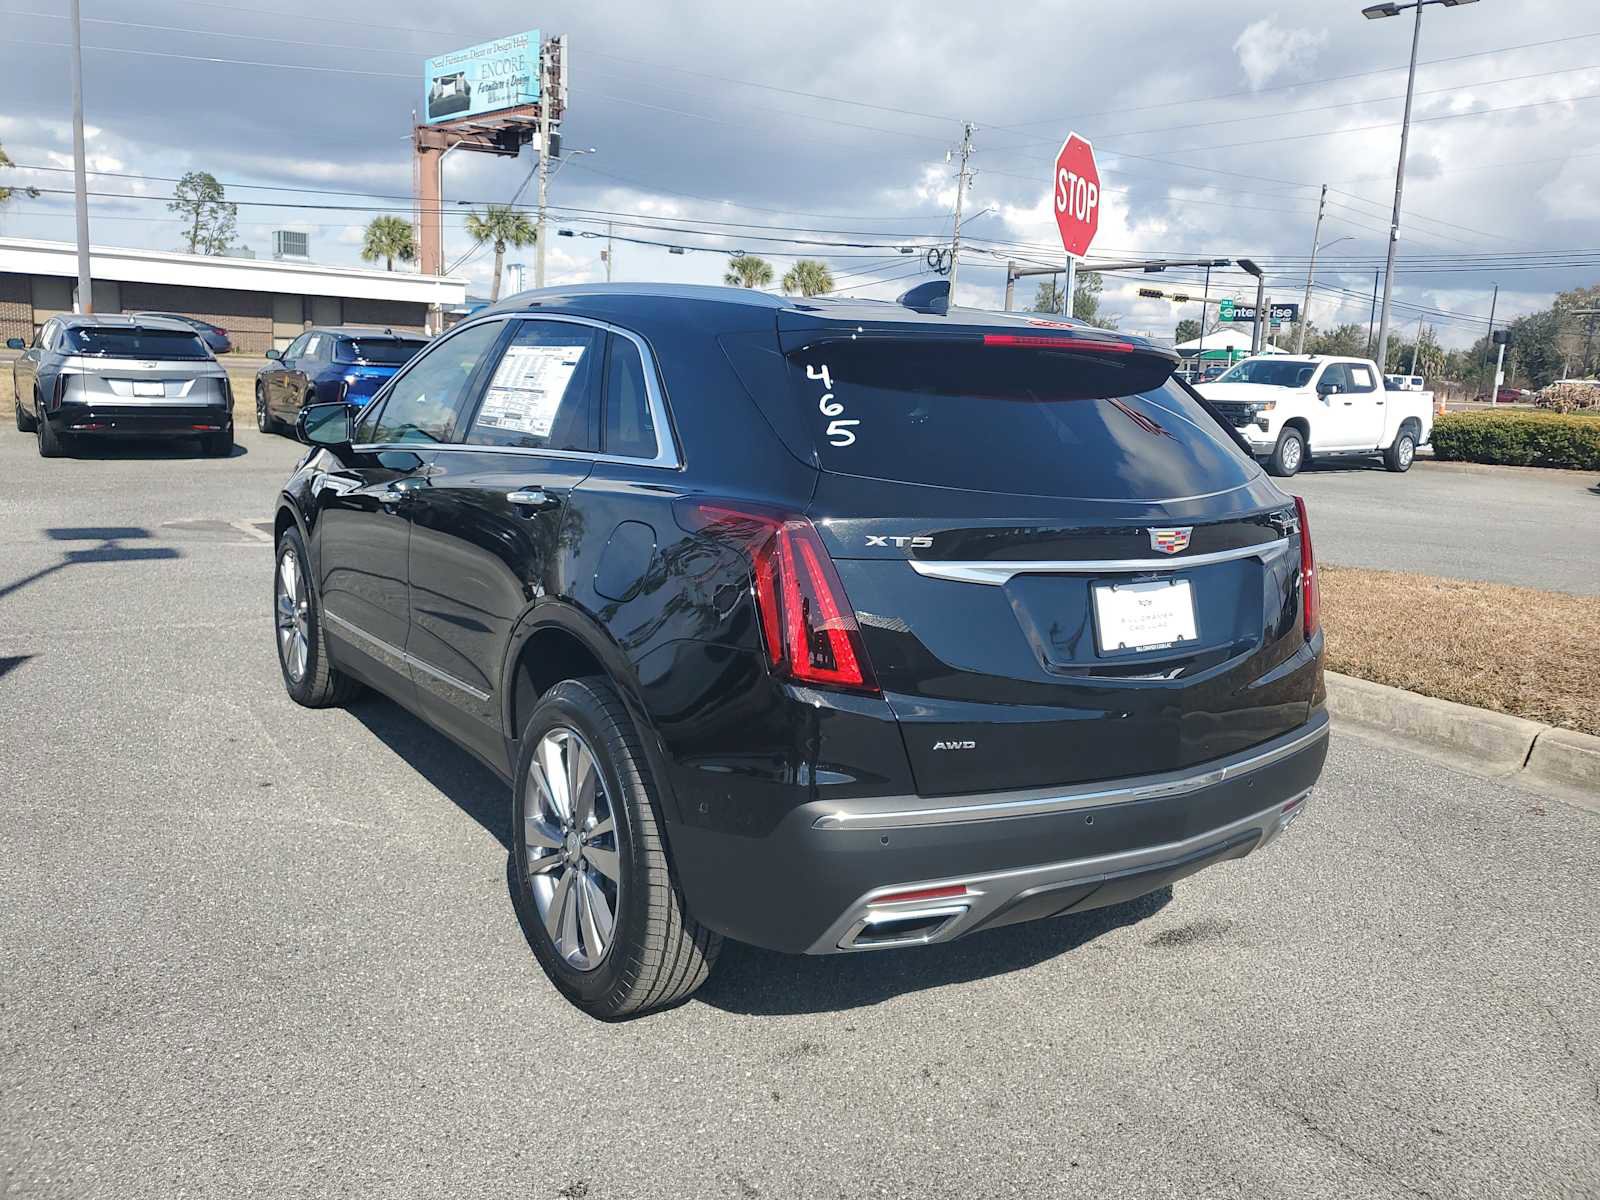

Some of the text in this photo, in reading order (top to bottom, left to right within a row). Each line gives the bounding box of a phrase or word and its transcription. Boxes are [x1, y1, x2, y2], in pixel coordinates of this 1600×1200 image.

[482, 54, 525, 79] ENCORE
[477, 80, 504, 95] Furniture
[1057, 167, 1098, 224] STOP
[1223, 306, 1293, 318] enterise
[865, 535, 934, 548] XT5
[933, 741, 976, 750] AWD
